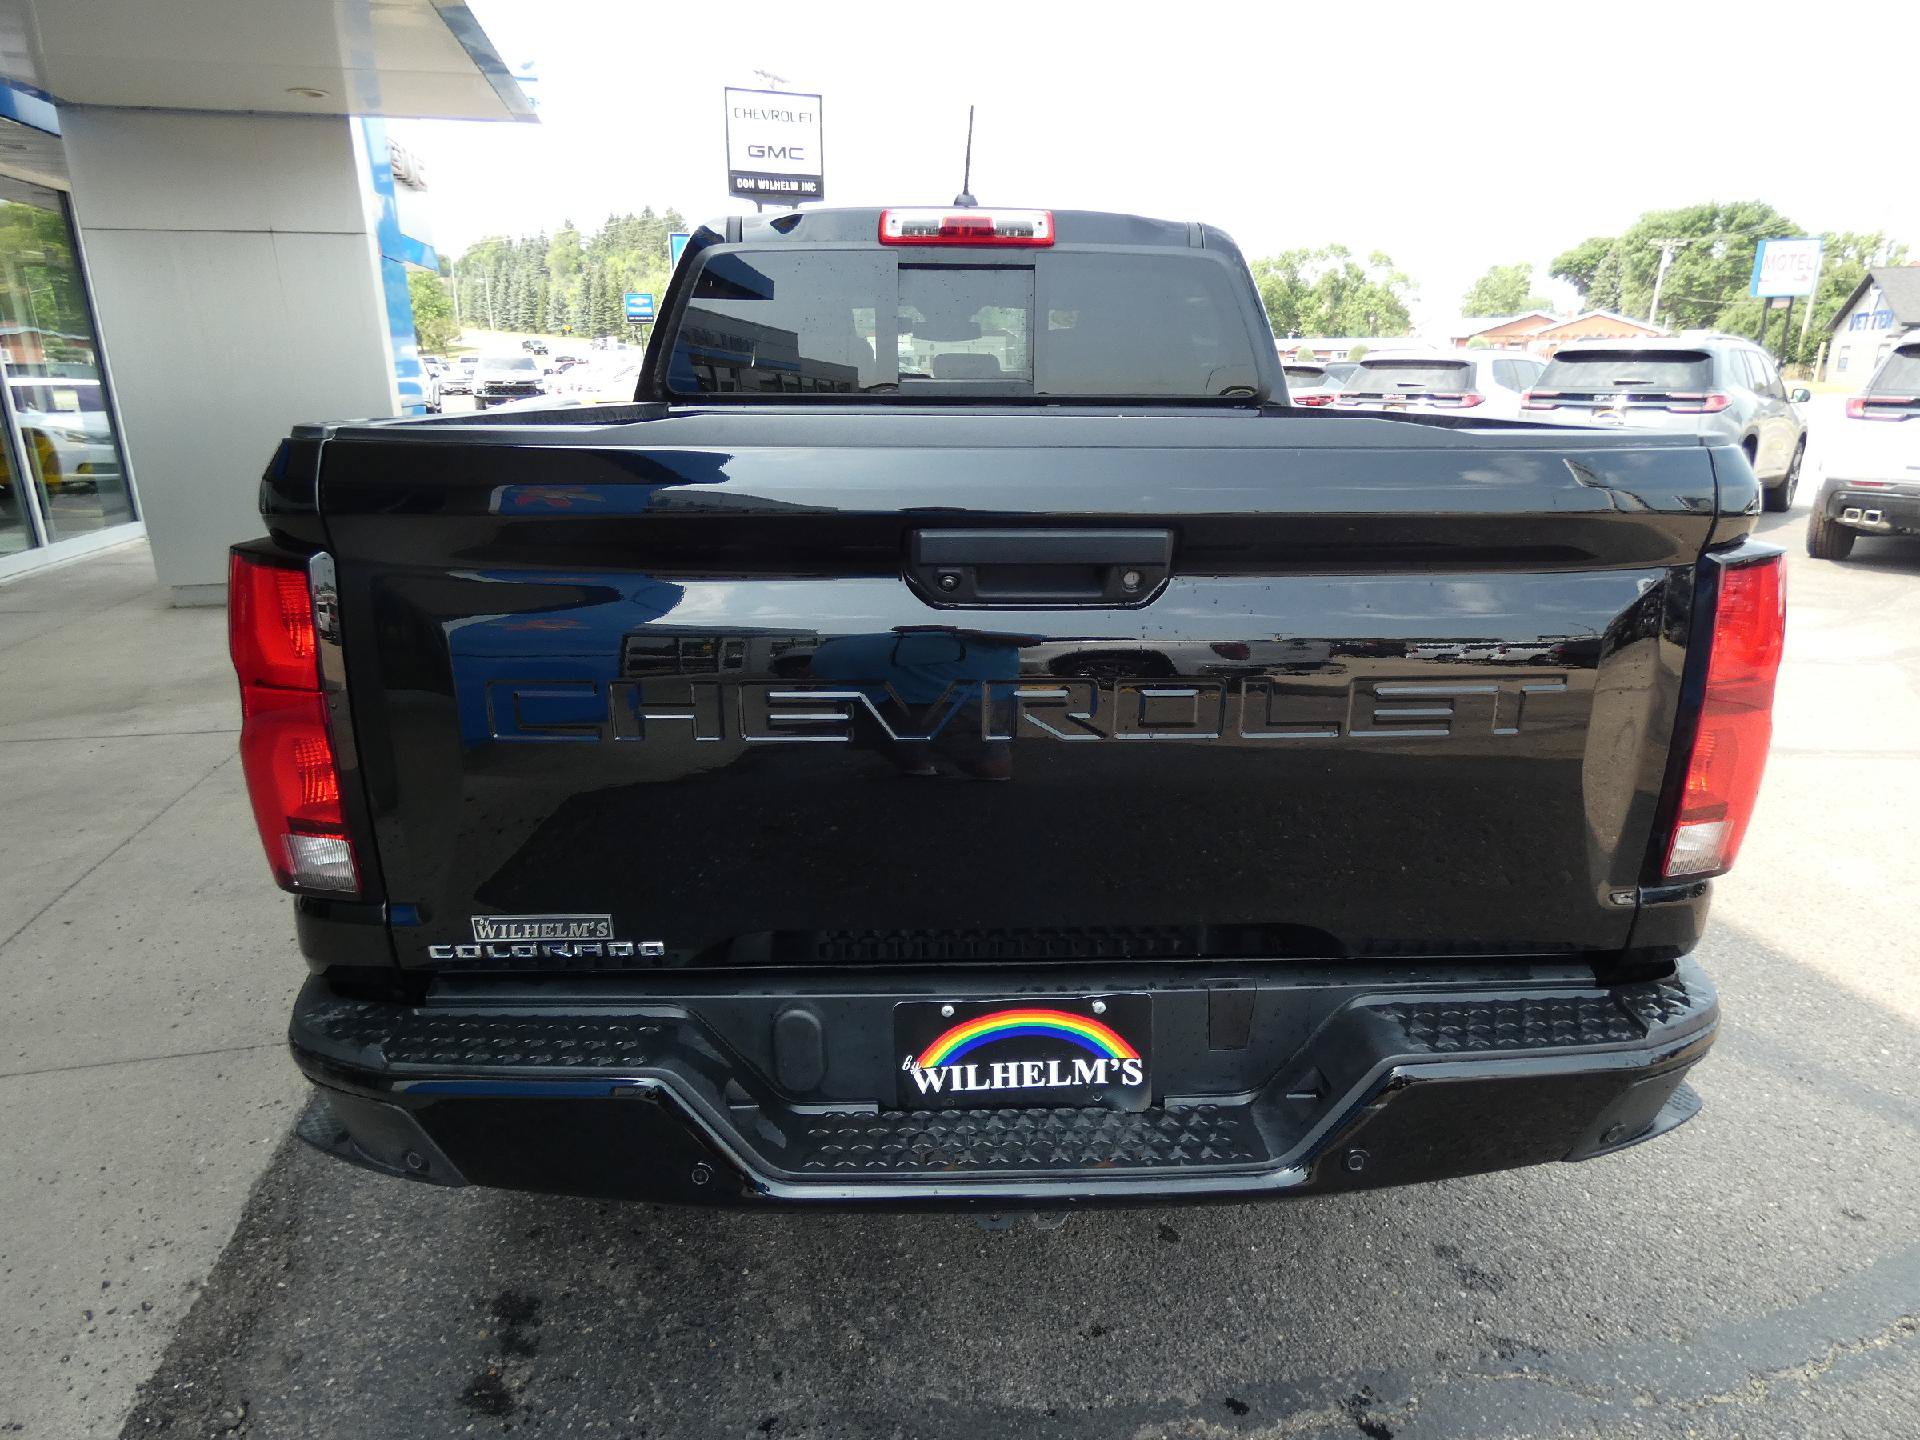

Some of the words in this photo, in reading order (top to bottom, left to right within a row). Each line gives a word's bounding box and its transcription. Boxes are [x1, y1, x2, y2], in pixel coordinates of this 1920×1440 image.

[734, 107, 812, 123] CHEVROLET
[748, 144, 804, 160] GMC
[736, 178, 755, 189] DON
[757, 179, 799, 190] WILHELM
[801, 181, 817, 192] INC
[1763, 253, 1813, 272] MOTEL
[485, 674, 1567, 742] CHEVROLET
[477, 921, 608, 939] WILHELM'S
[428, 941, 665, 959] COLORADO
[901, 1054, 922, 1075] by
[910, 1058, 1143, 1095] WILHELM'S
